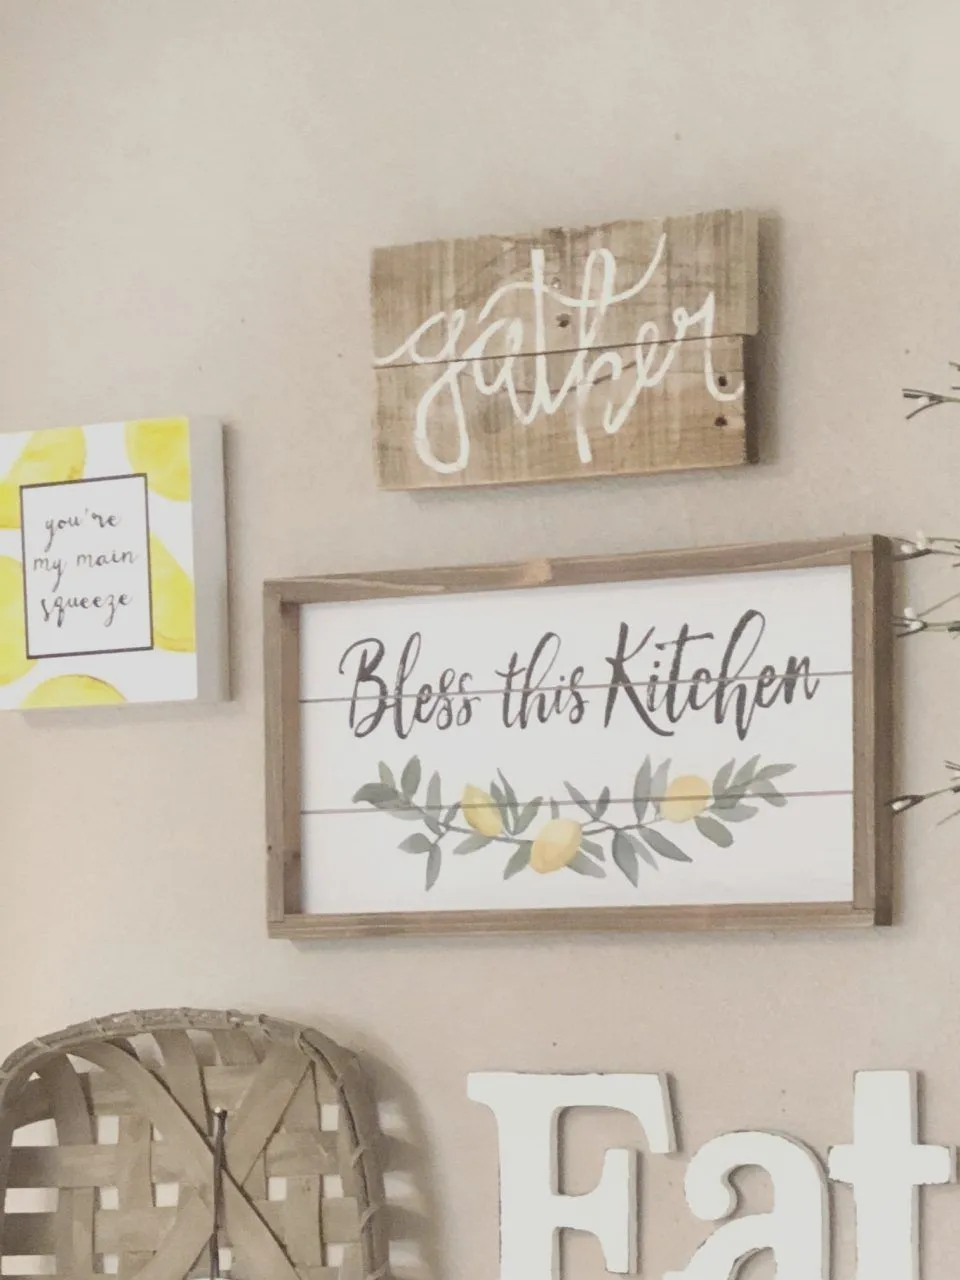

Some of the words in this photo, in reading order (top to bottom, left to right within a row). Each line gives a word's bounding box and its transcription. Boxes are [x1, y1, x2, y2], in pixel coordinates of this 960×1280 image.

[374, 232, 744, 473] gather
[44, 507, 119, 552] you're
[33, 556, 66, 593] my
[76, 550, 136, 568] main
[40, 594, 132, 628] squeeze
[338, 632, 481, 740] Bless
[495, 632, 591, 730] this
[603, 609, 821, 741] Kitchen
